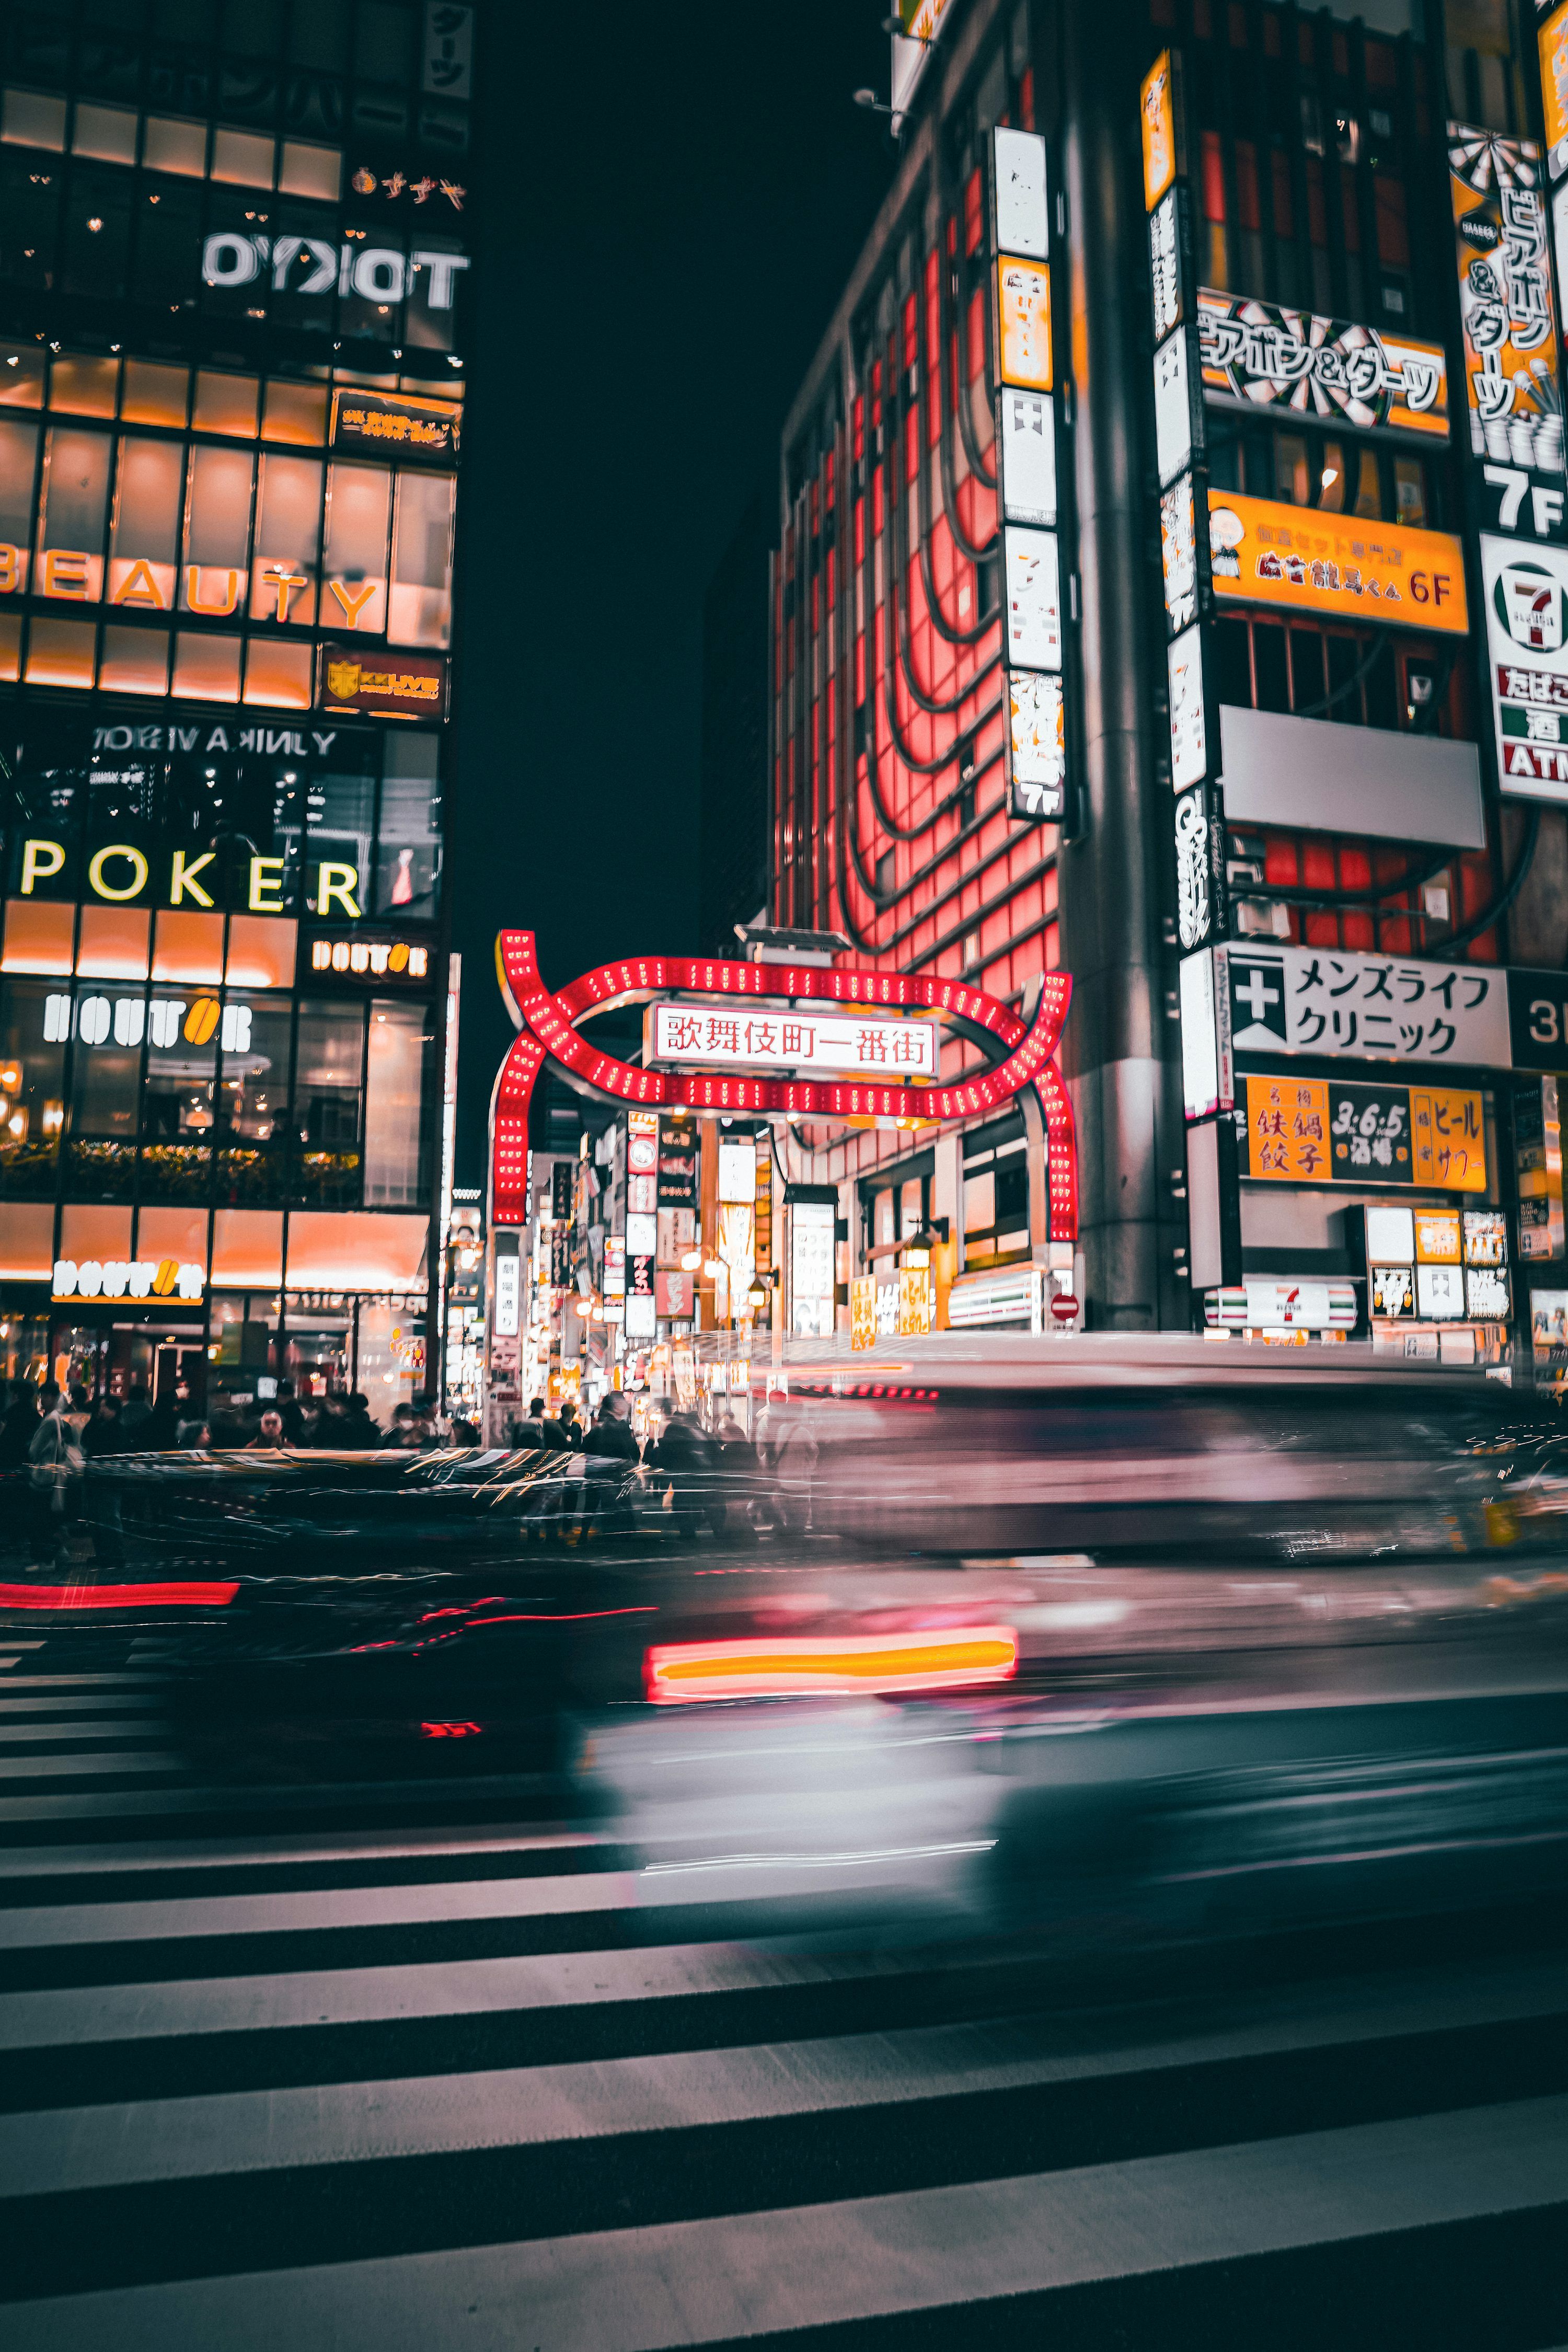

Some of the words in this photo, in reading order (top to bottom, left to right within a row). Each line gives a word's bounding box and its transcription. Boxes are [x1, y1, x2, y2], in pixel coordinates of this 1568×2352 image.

[1483, 464, 1565, 538] 7F
[1410, 571, 1450, 606] 6F
[1527, 708, 1561, 741] 酒
[19, 839, 363, 918] POKER
[1296, 959, 1489, 1010] メンズライフ
[668, 1016, 925, 1064] 歌舞伎町一番街
[1297, 1007, 1456, 1055] クリニック
[1529, 1000, 1568, 1043] 3
[1256, 1109, 1323, 1142] 鉄鍋
[1434, 1100, 1480, 1139] ビール
[1259, 1140, 1324, 1174] 餃子
[1438, 1146, 1482, 1181] サワー
